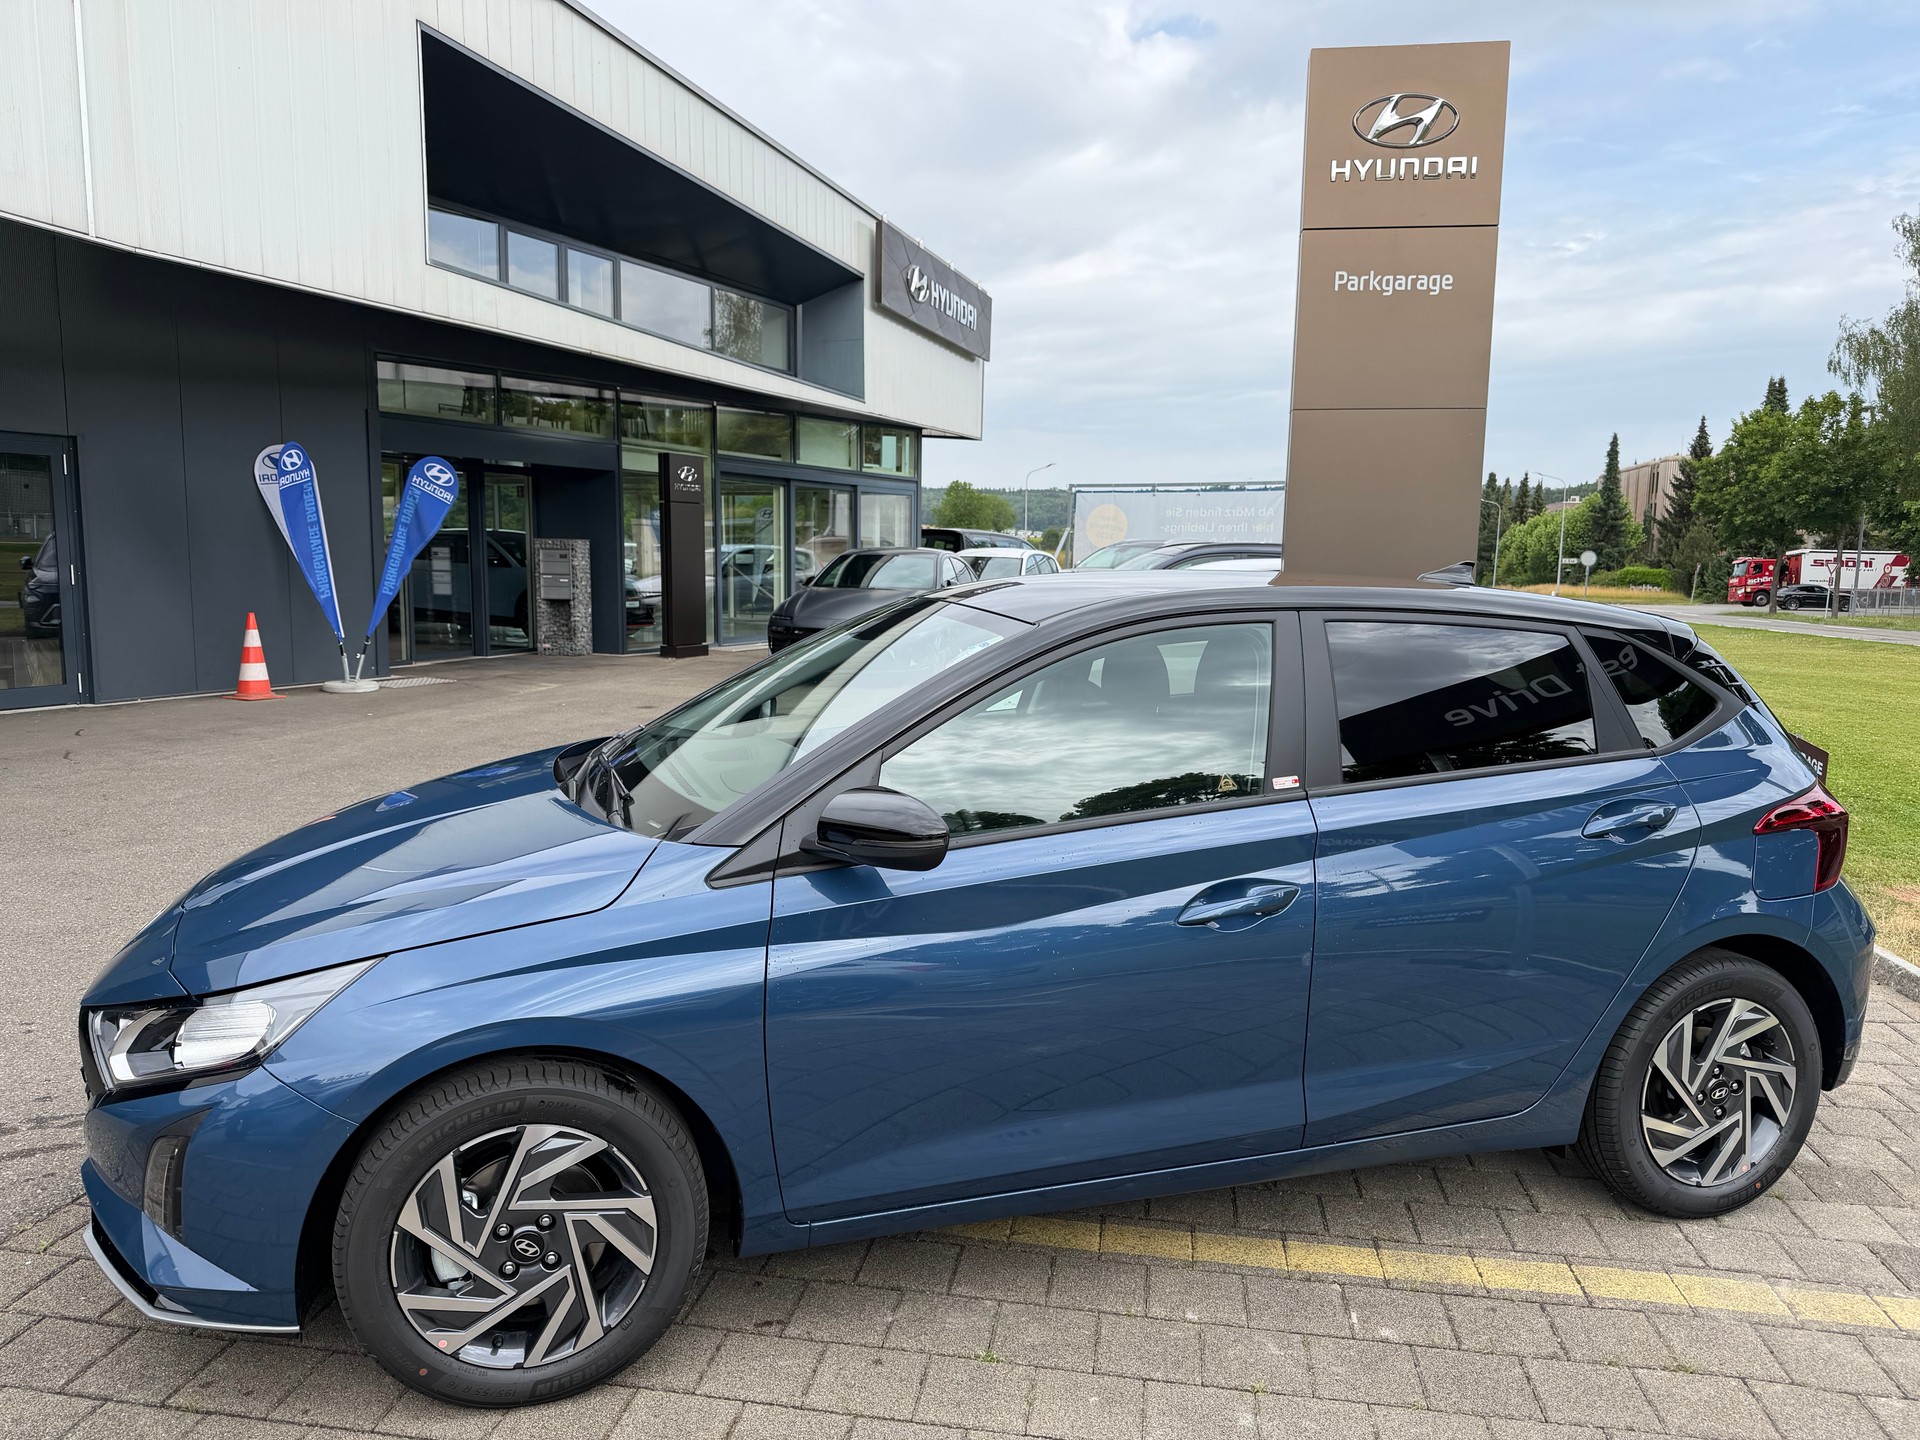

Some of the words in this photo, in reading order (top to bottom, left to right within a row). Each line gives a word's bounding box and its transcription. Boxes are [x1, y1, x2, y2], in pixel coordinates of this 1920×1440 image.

[1330, 156, 1478, 182] HYUNDAI
[1334, 270, 1454, 296] Parkgarage
[930, 280, 977, 331] HYUNDAI
[412, 474, 454, 502] HYUNDAI
[382, 525, 409, 596] PARKGARAGE
[401, 487, 421, 524] BADEN
[1747, 576, 1774, 585] schön
[417, 1100, 520, 1151] MICHELIN
